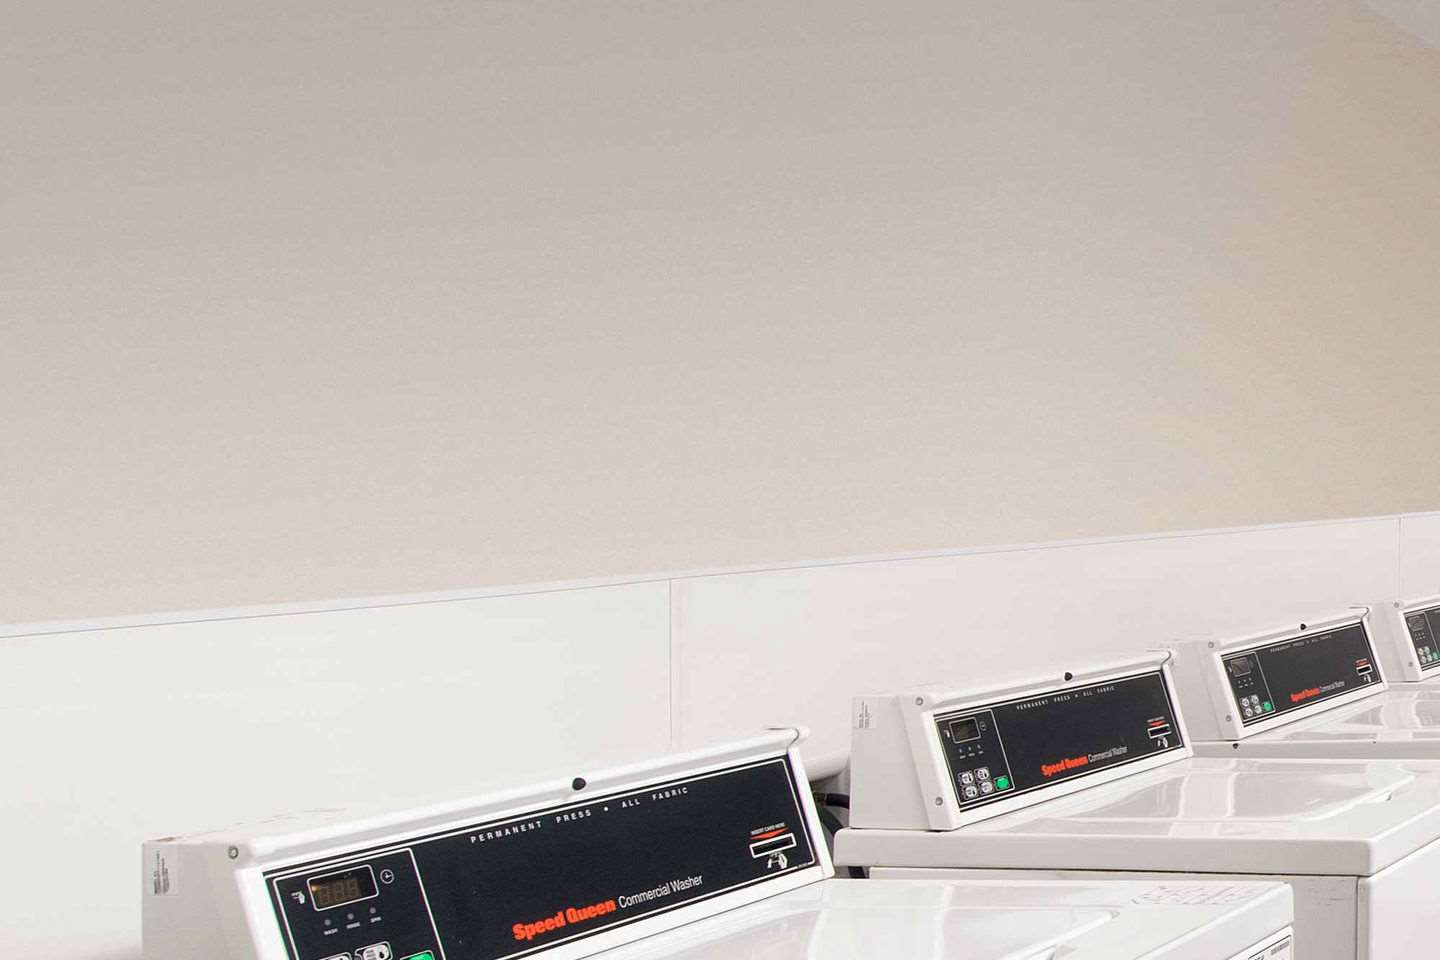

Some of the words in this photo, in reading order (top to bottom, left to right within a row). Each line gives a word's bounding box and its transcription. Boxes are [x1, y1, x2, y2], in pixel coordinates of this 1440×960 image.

[1041, 760, 1066, 777] Speed
[1064, 755, 1089, 769] Queen
[470, 820, 543, 845] PERMANENT
[555, 808, 593, 824] PRESS
[621, 798, 642, 810] ALL
[652, 786, 690, 802] FABRIC
[512, 911, 567, 942] Speed
[565, 899, 618, 925] Queen
[618, 882, 671, 909] Commercial
[670, 875, 704, 894] Washer
